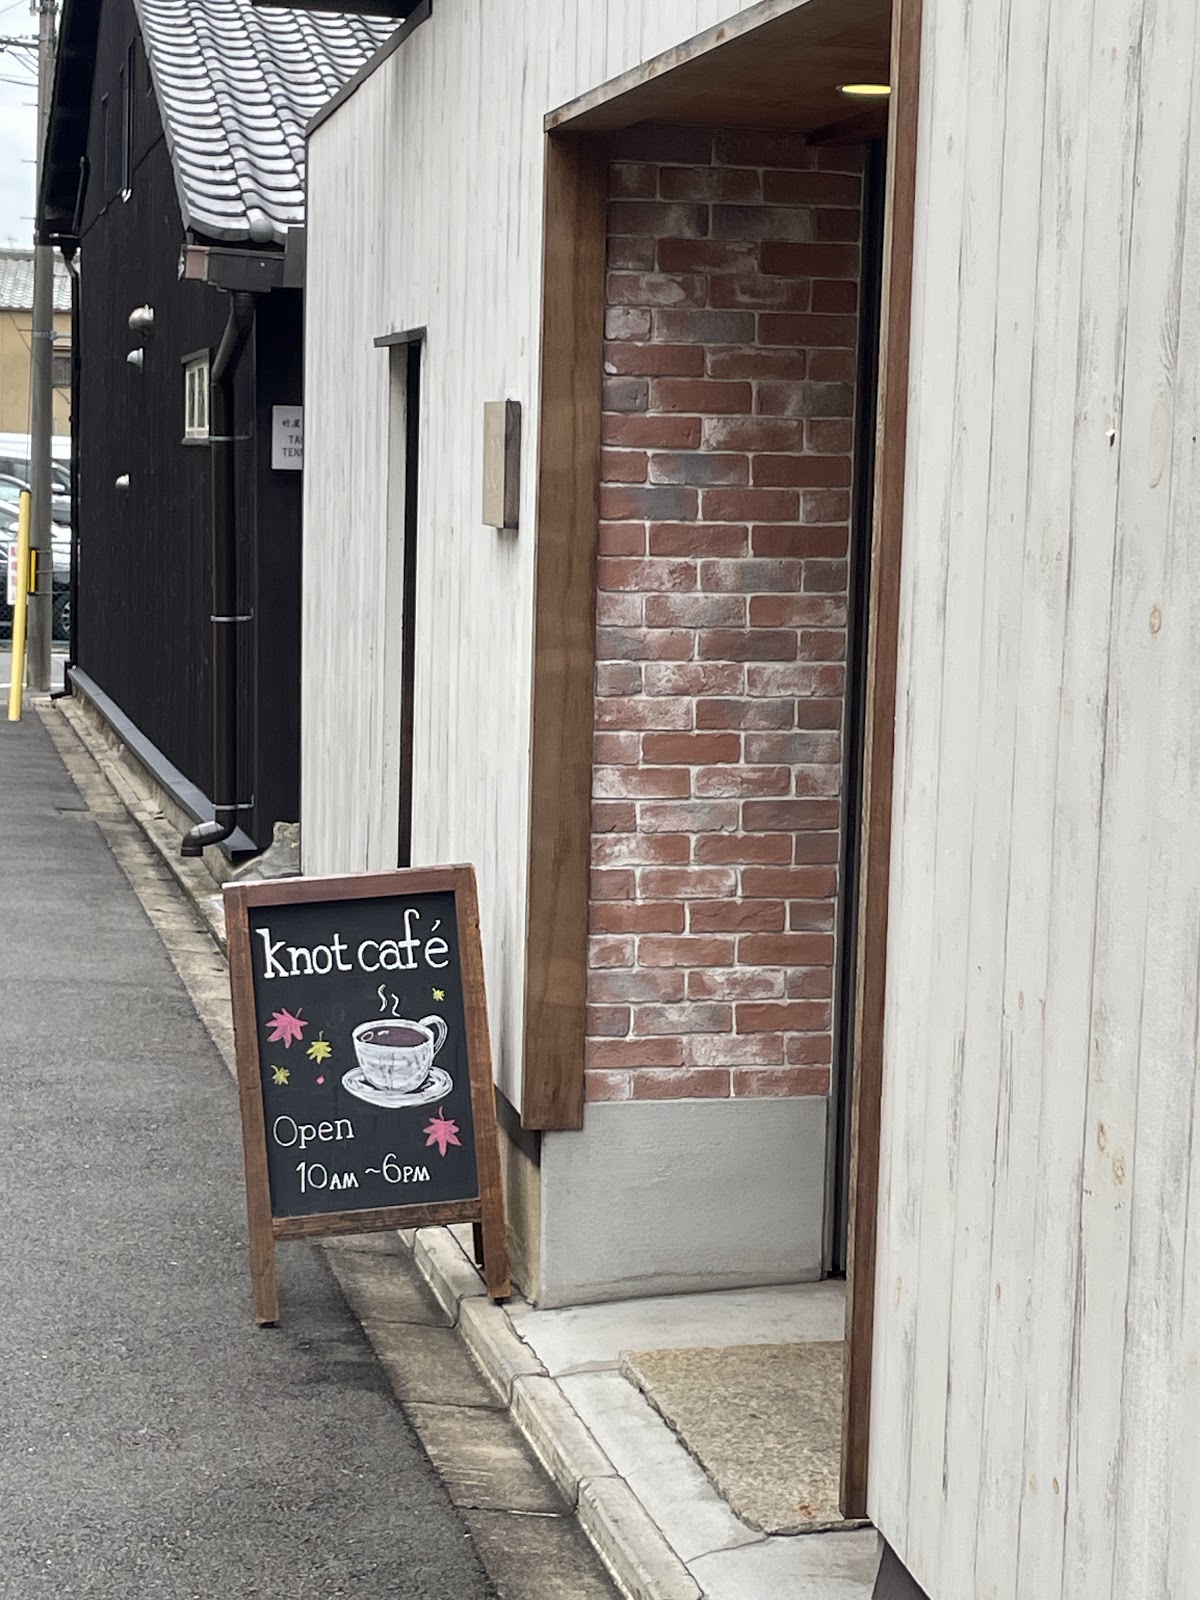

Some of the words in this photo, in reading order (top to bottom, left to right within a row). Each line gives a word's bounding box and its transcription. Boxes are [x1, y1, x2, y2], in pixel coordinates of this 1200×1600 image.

[256, 928, 352, 979] knot
[357, 908, 449, 972] café
[273, 1115, 355, 1149] Open
[296, 1162, 360, 1193] 10AM
